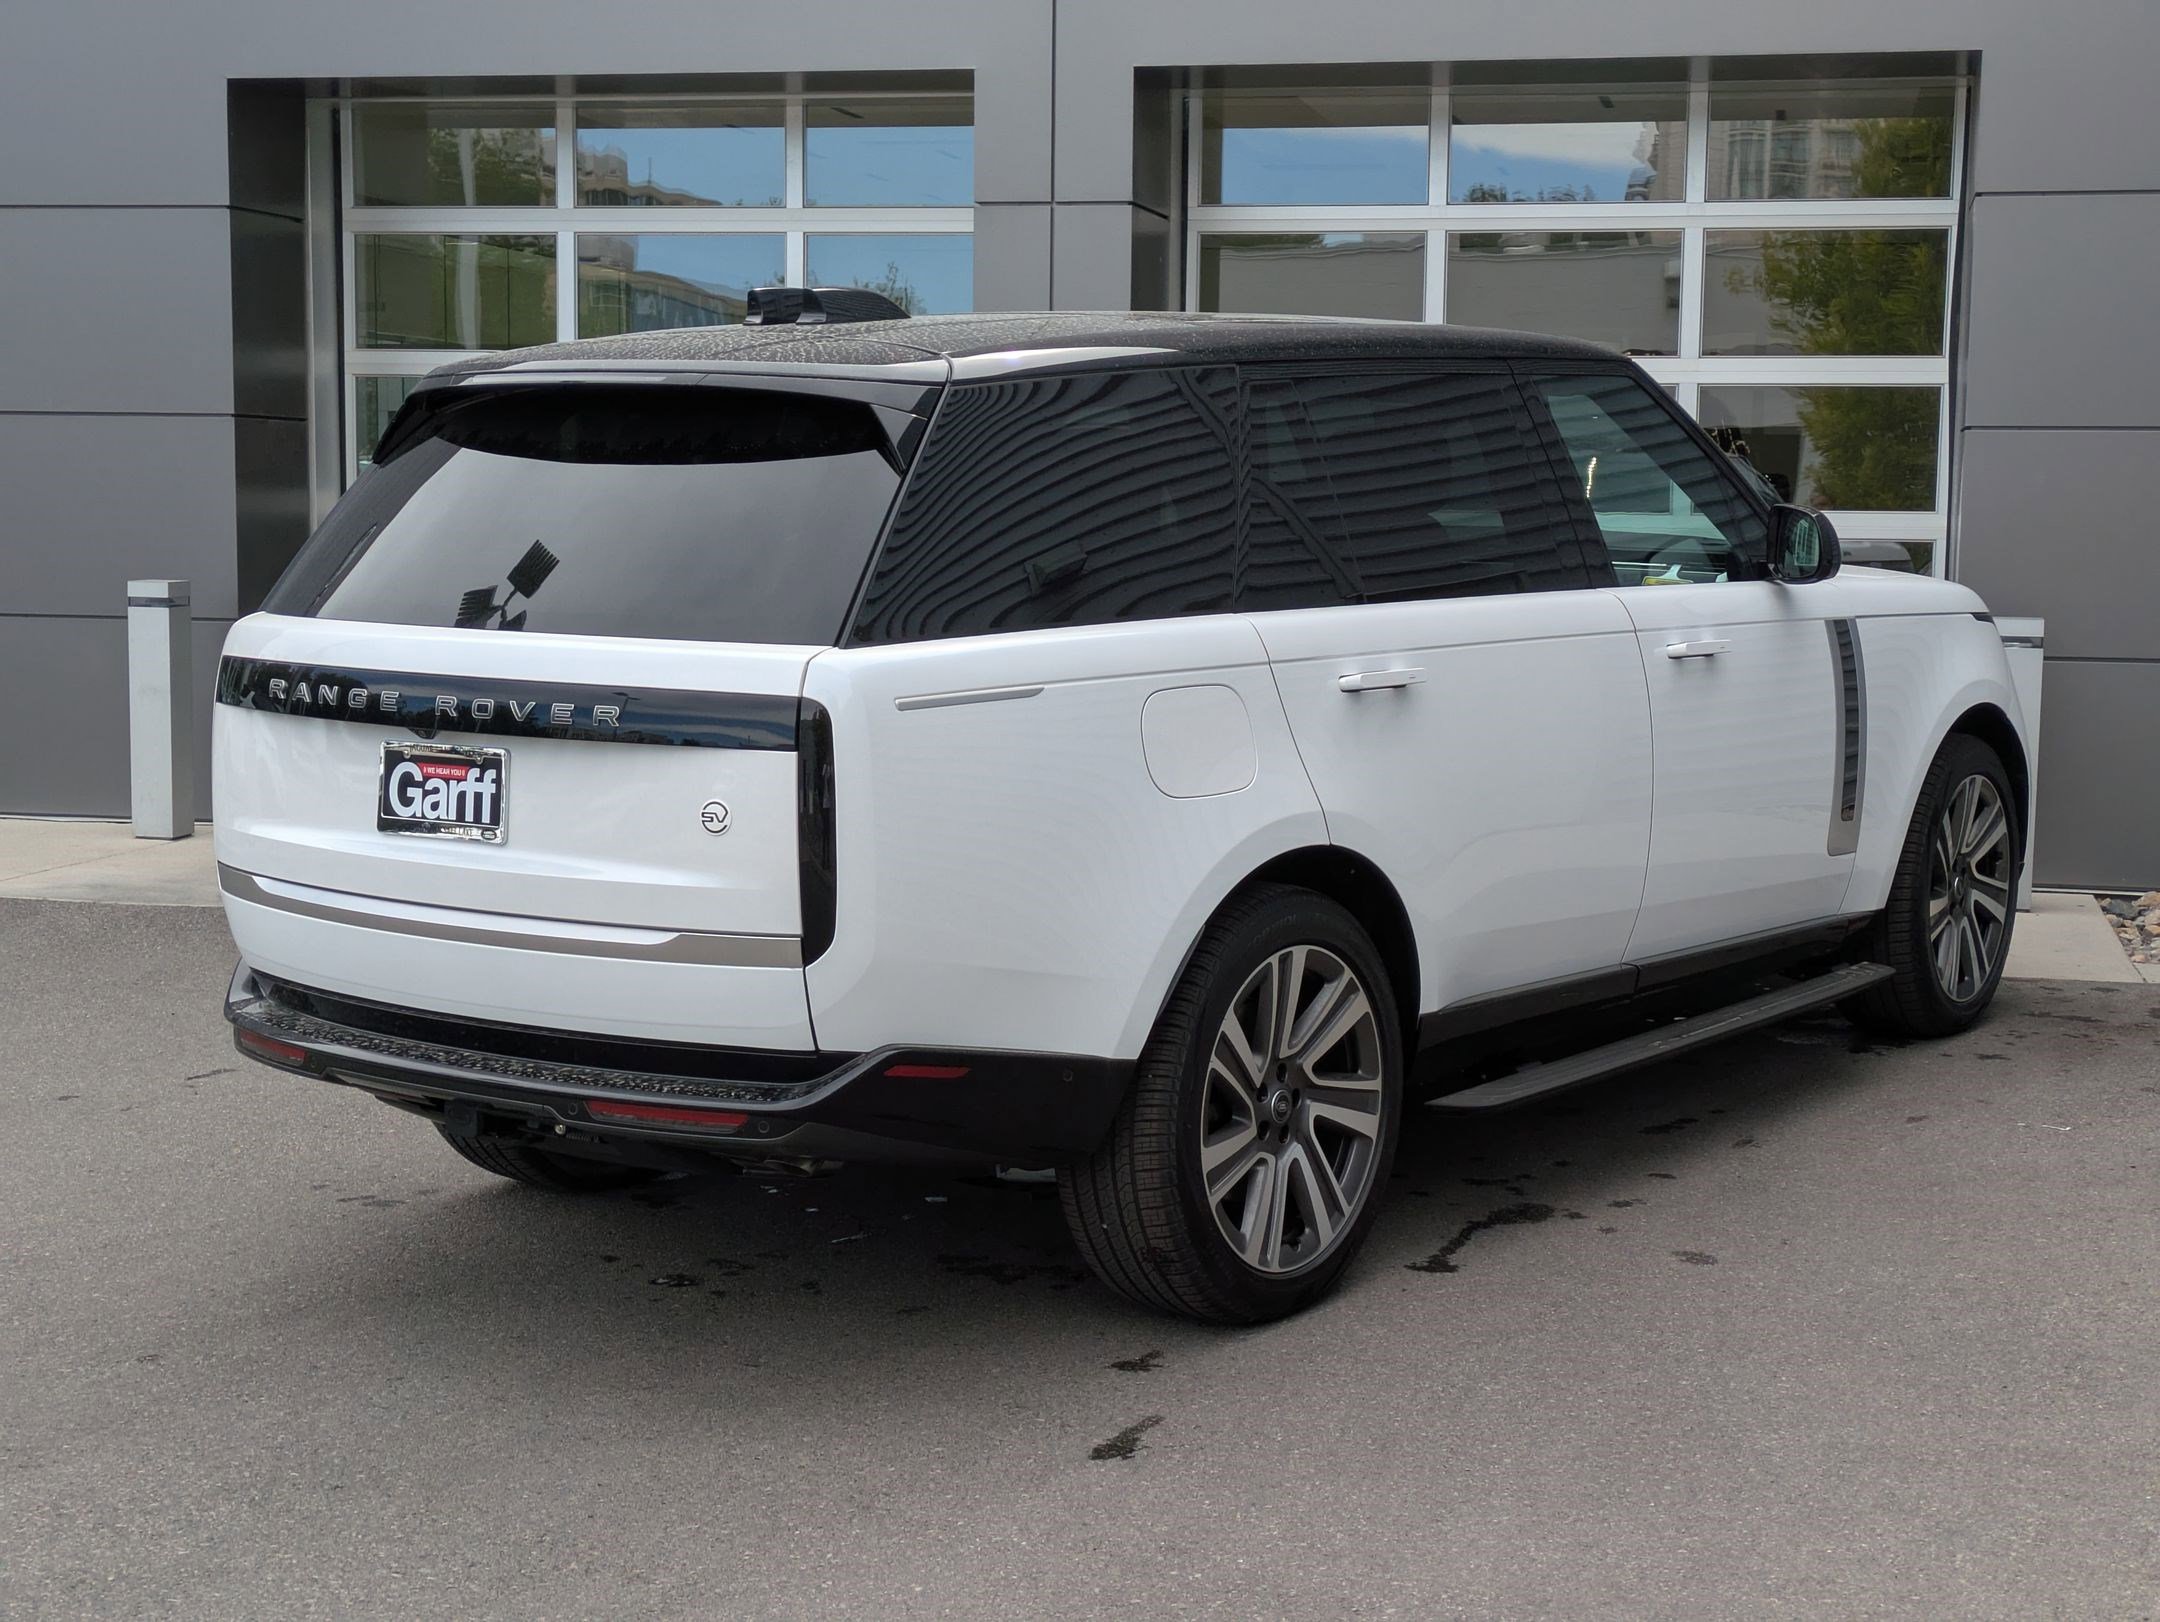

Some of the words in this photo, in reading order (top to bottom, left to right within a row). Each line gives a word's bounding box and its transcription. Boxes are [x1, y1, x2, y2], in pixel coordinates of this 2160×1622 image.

[268, 678, 400, 712] RANGE
[434, 695, 620, 727] ROVER
[389, 761, 497, 824] Garff
[450, 768, 462, 776] YOU
